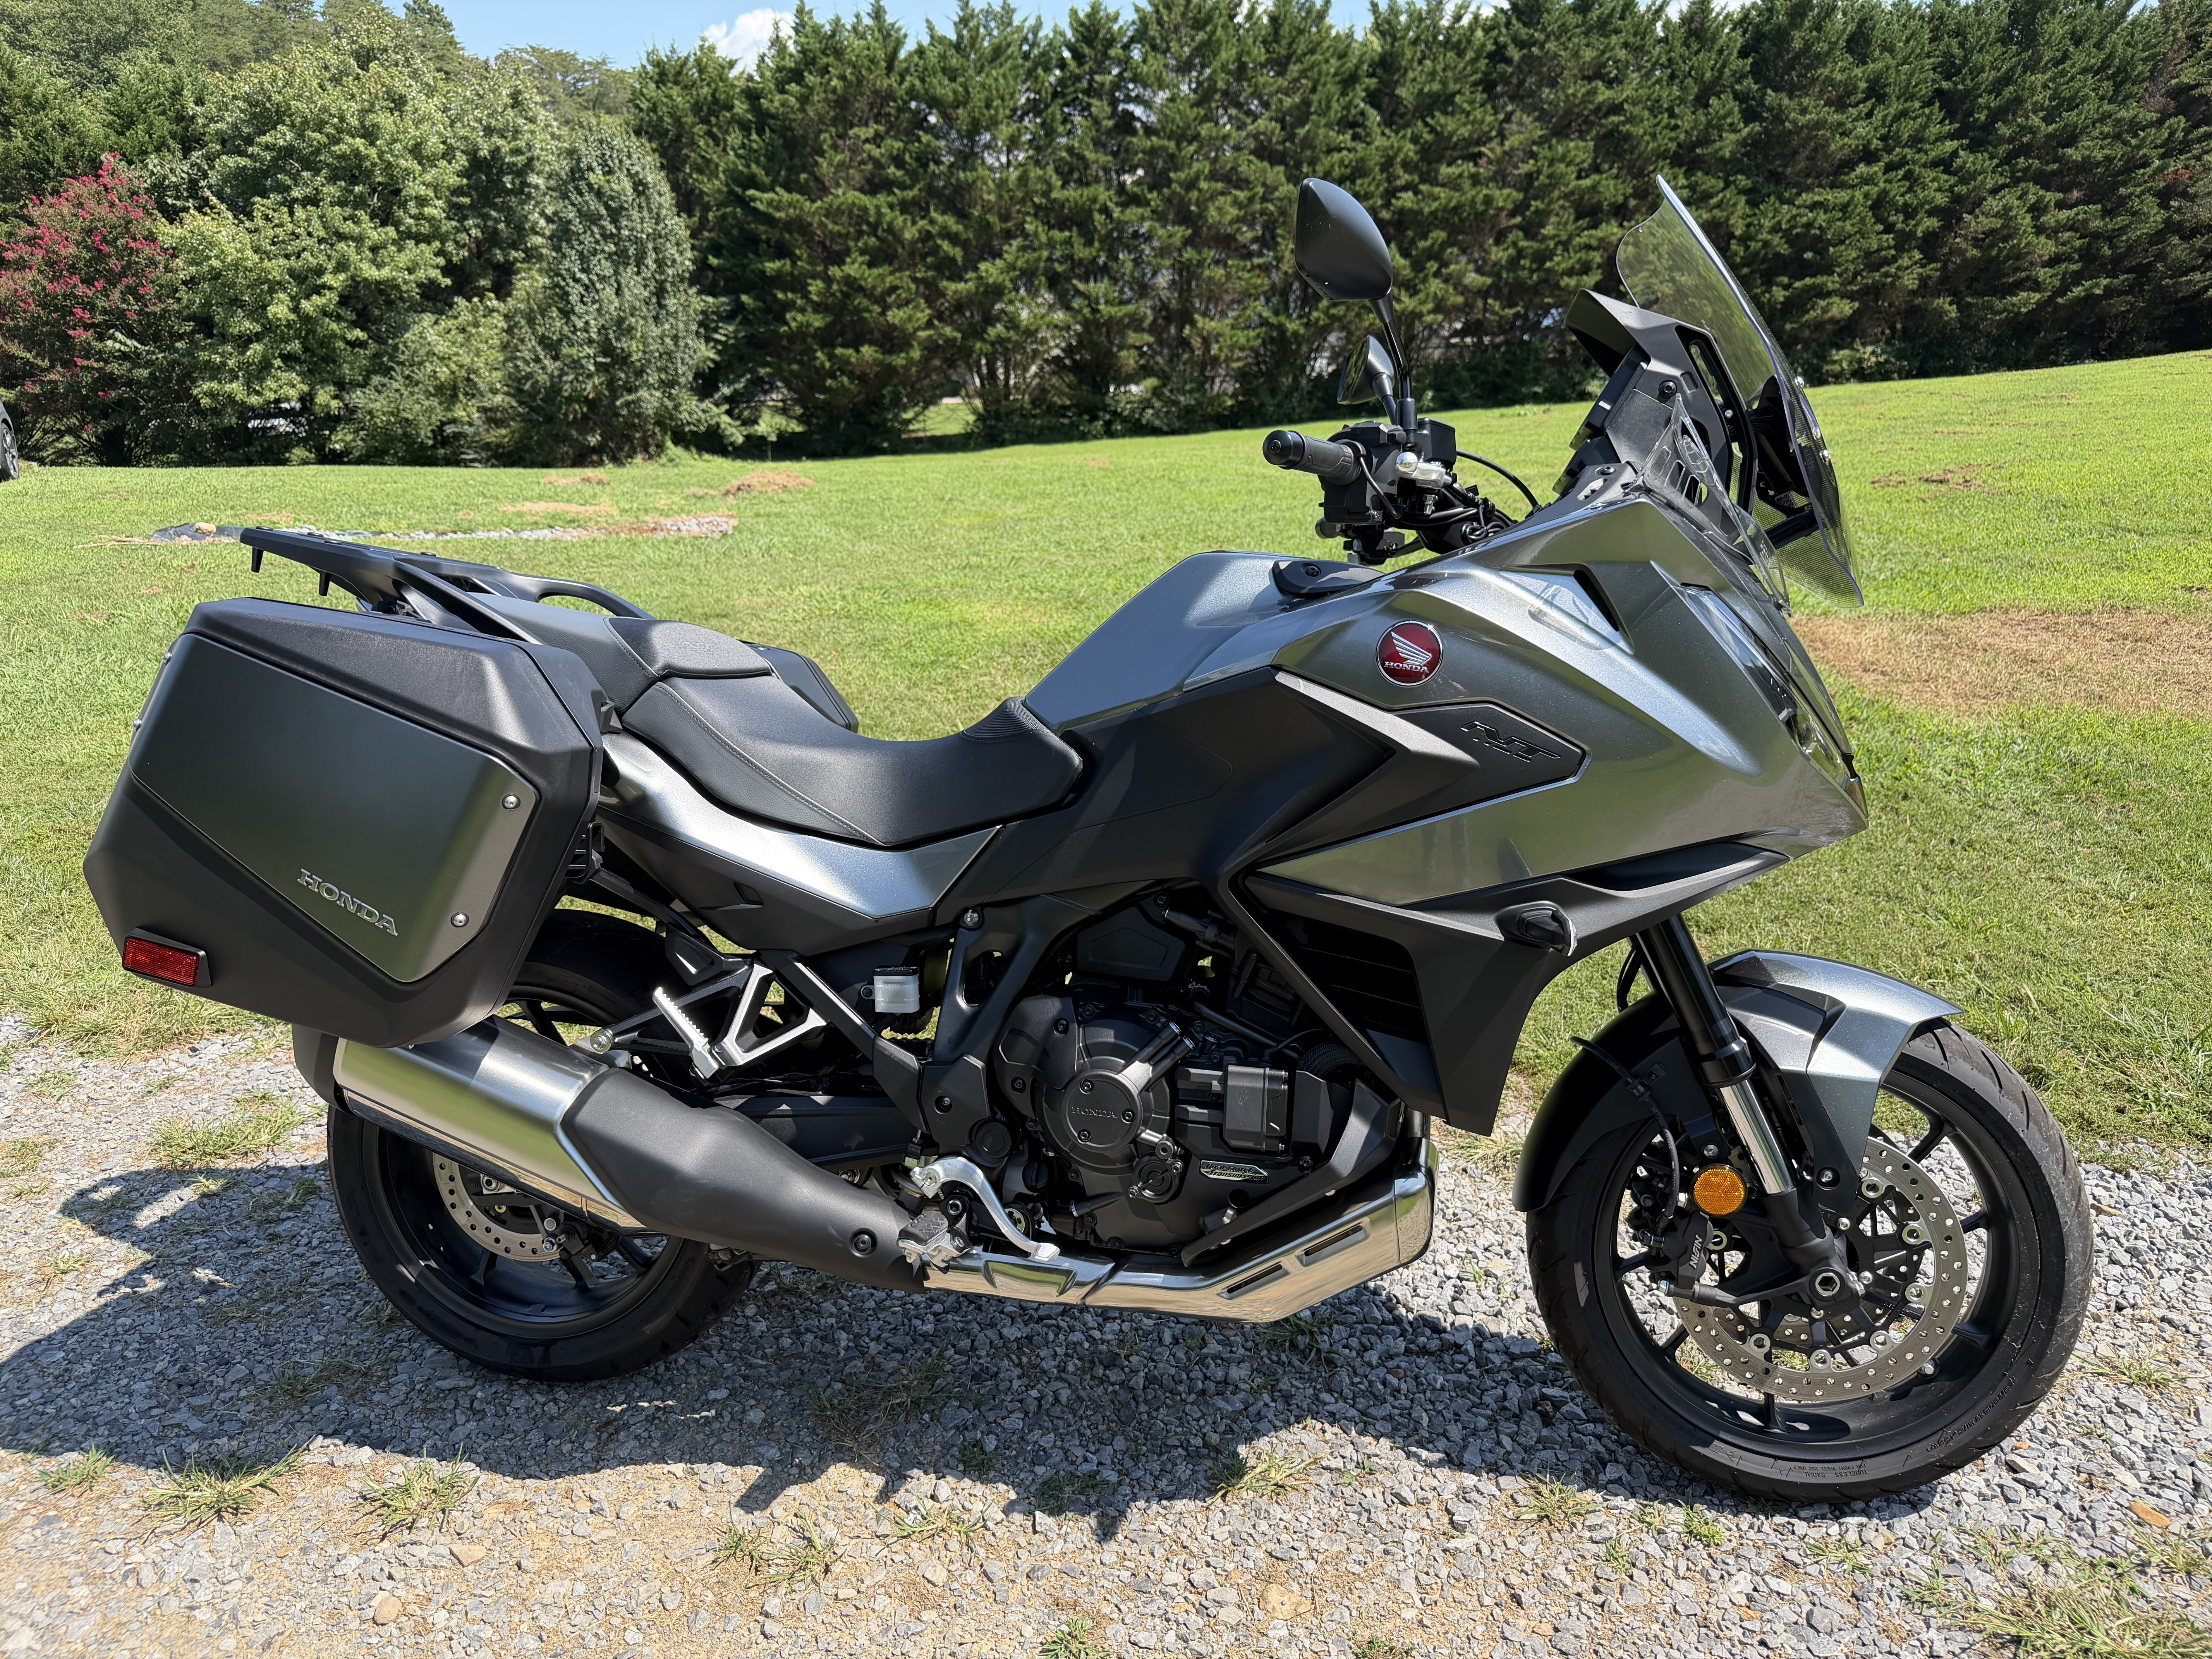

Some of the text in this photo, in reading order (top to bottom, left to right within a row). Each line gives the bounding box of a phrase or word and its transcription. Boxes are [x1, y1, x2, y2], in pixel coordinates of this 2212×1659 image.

[1384, 661, 1429, 673] HONDA
[1460, 720, 1561, 762] NT
[297, 868, 398, 936] HONDA
[1071, 1107, 1118, 1118] HONDA
[1208, 1170, 1266, 1181] Transmission
[1690, 1235, 1703, 1268] NISSIN
[1835, 1469, 1868, 1477] TUBELESS
